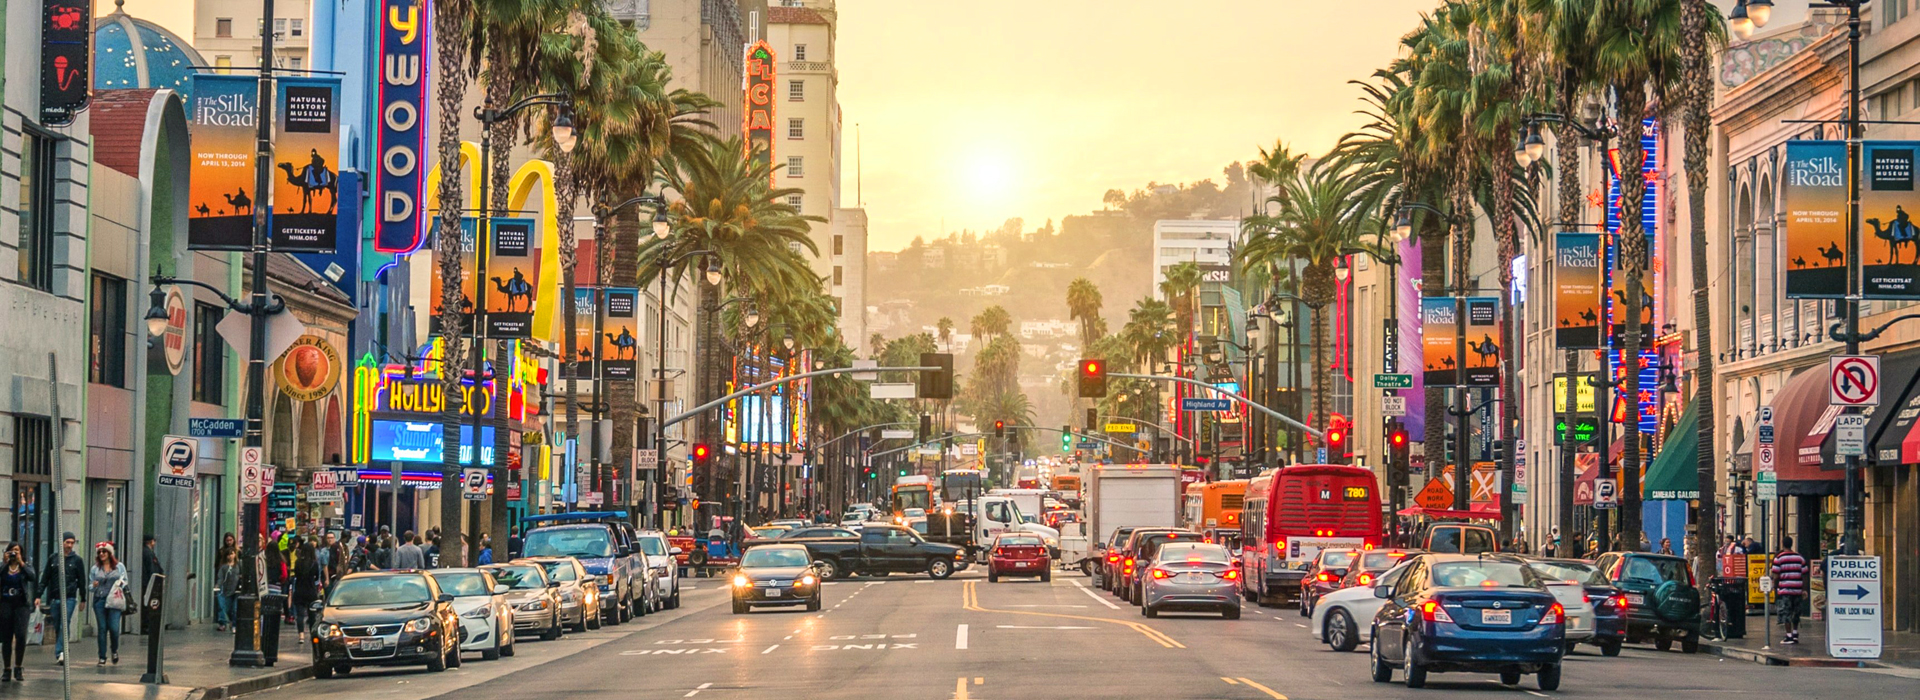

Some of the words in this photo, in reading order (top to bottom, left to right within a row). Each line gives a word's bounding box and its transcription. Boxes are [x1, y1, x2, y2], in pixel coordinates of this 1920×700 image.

[750, 59, 772, 80] EL
[204, 96, 217, 106] The
[218, 94, 249, 113] Silk
[203, 106, 254, 127] Road
[1809, 157, 1838, 174] Silk
[1796, 168, 1843, 186] Road
[1572, 246, 1593, 258] Silk
[1564, 254, 1597, 267] Road
[1435, 307, 1451, 316] Silk
[1428, 313, 1454, 324] Road
[315, 336, 337, 362] KING
[284, 384, 306, 400] Since
[308, 386, 328, 399] 1989
[192, 420, 234, 429] McCadden
[315, 473, 336, 484] ATM
[1321, 490, 1330, 499] M
[1347, 487, 1364, 498] 780
[432, 557, 438, 566] 5
